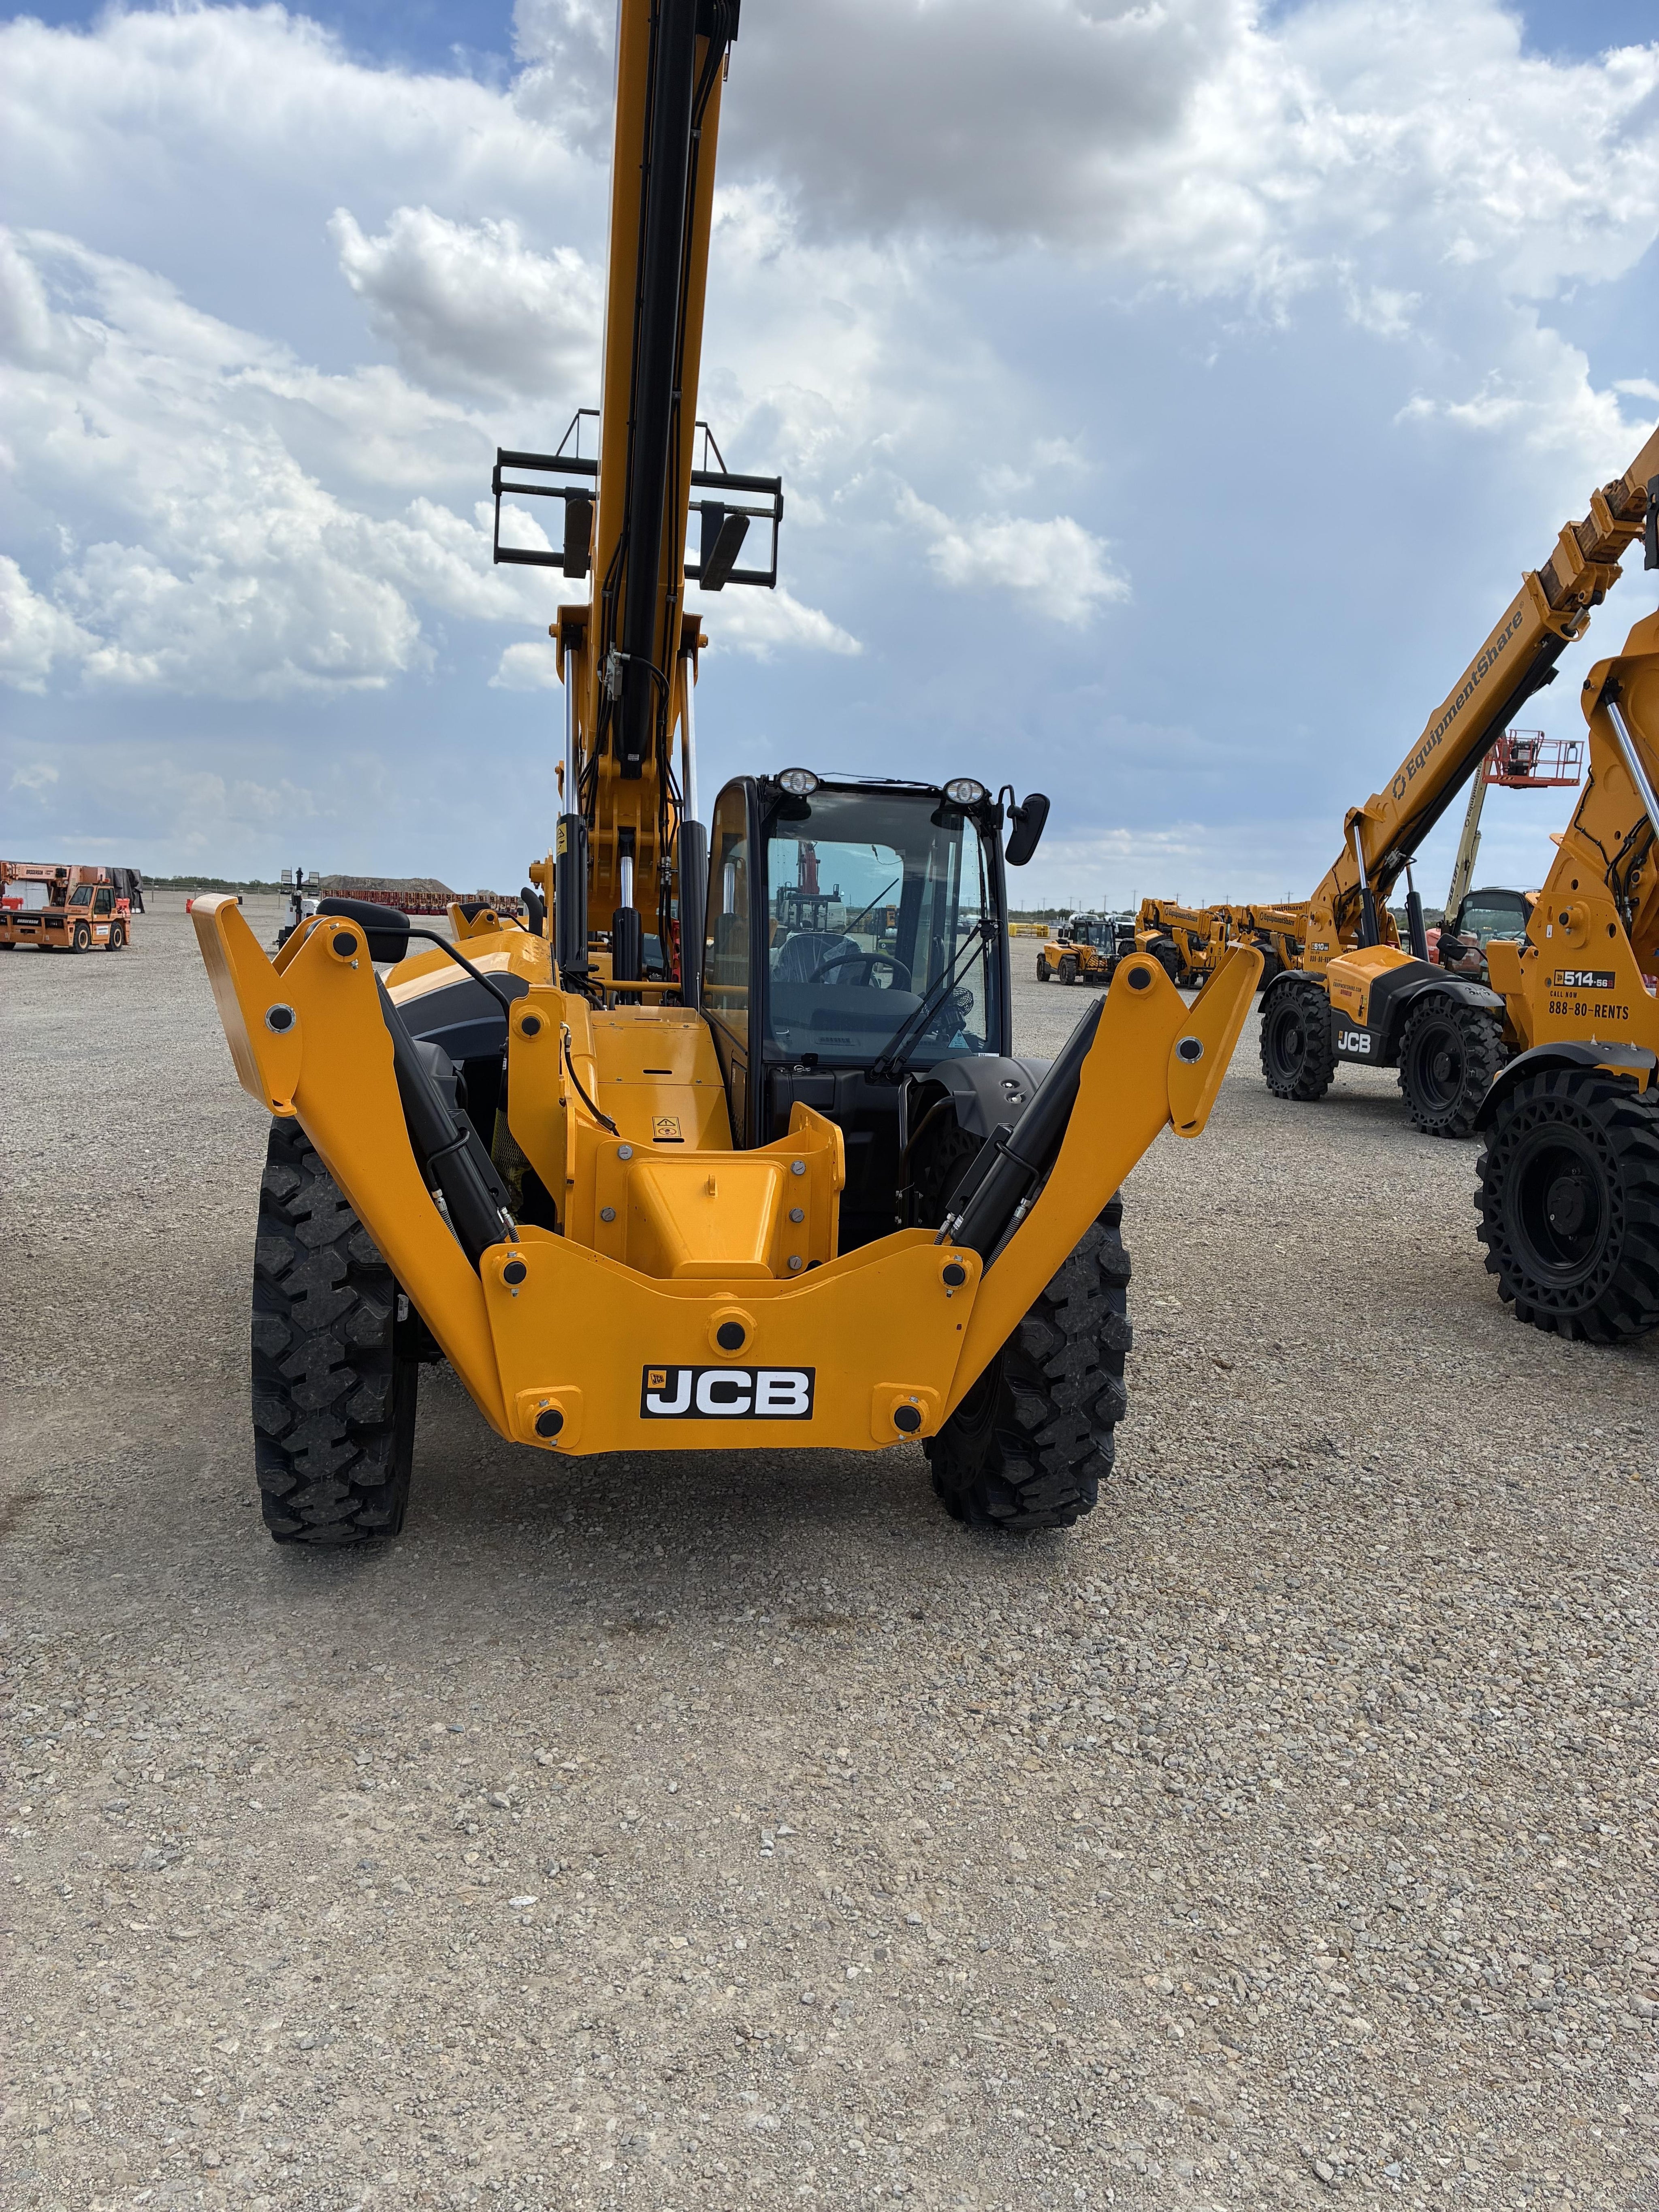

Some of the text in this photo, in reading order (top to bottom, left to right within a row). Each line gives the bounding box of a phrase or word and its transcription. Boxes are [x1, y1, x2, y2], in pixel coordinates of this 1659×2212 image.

[1405, 610, 1523, 781] EquipmentShare
[1549, 1000, 1629, 1020] 888-80-RENTS
[1338, 1031, 1371, 1054] JCB
[646, 1370, 809, 1414] JCB
